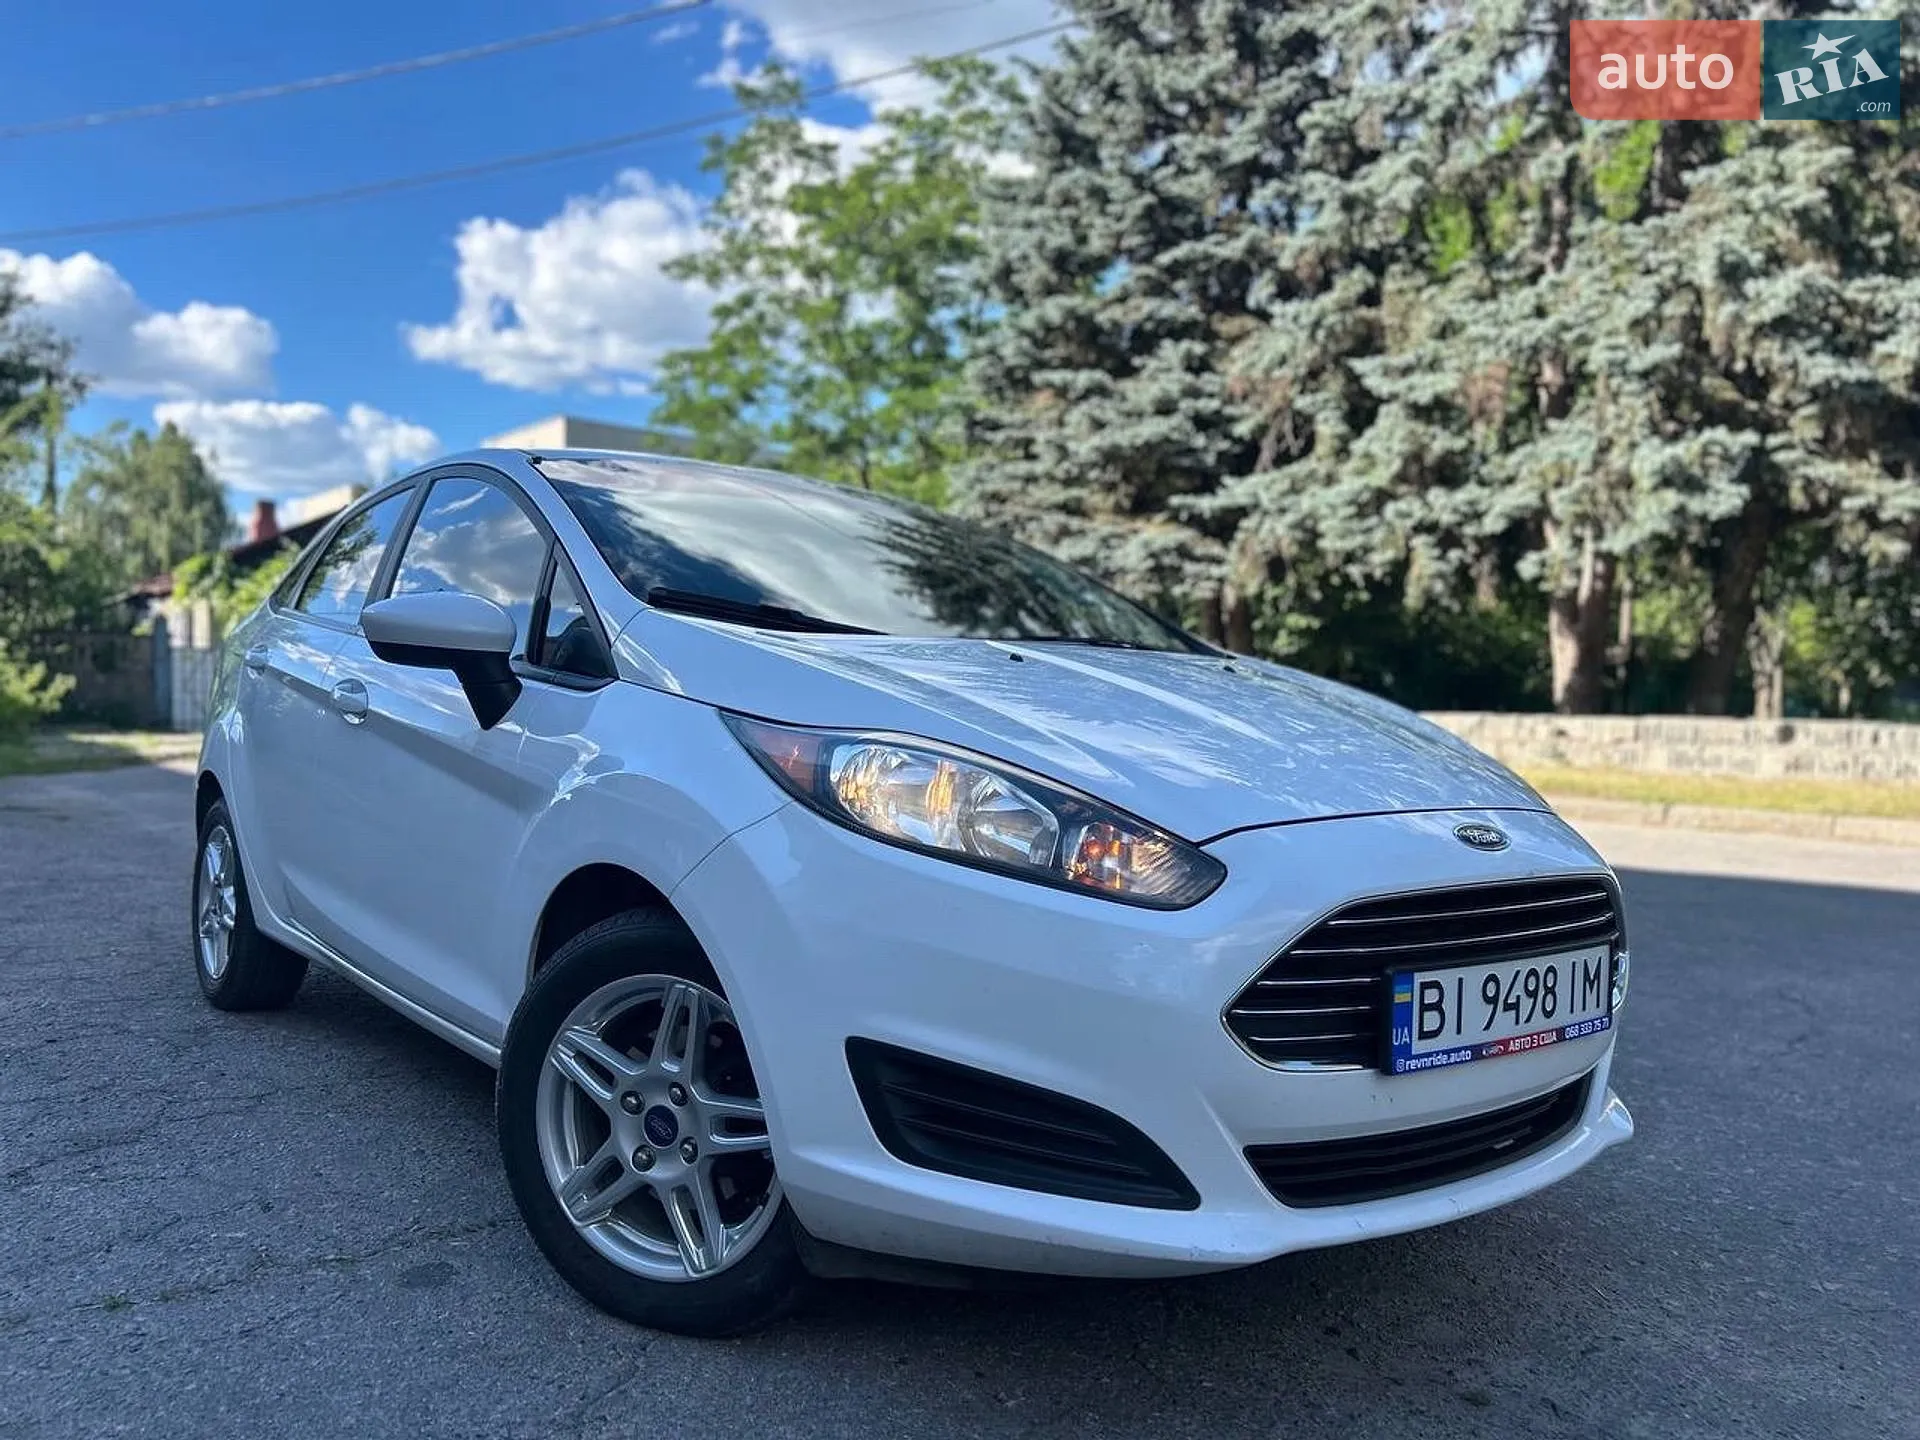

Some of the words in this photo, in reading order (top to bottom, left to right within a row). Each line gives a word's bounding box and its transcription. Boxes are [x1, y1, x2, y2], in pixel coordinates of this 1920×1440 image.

[1417, 977, 1464, 1041] BI
[1481, 965, 1558, 1031] 9498
[1569, 956, 1602, 1014] IM
[1392, 1028, 1410, 1046] UA
[1508, 1036, 1531, 1052] АВТО
[1539, 1031, 1557, 1046] США
